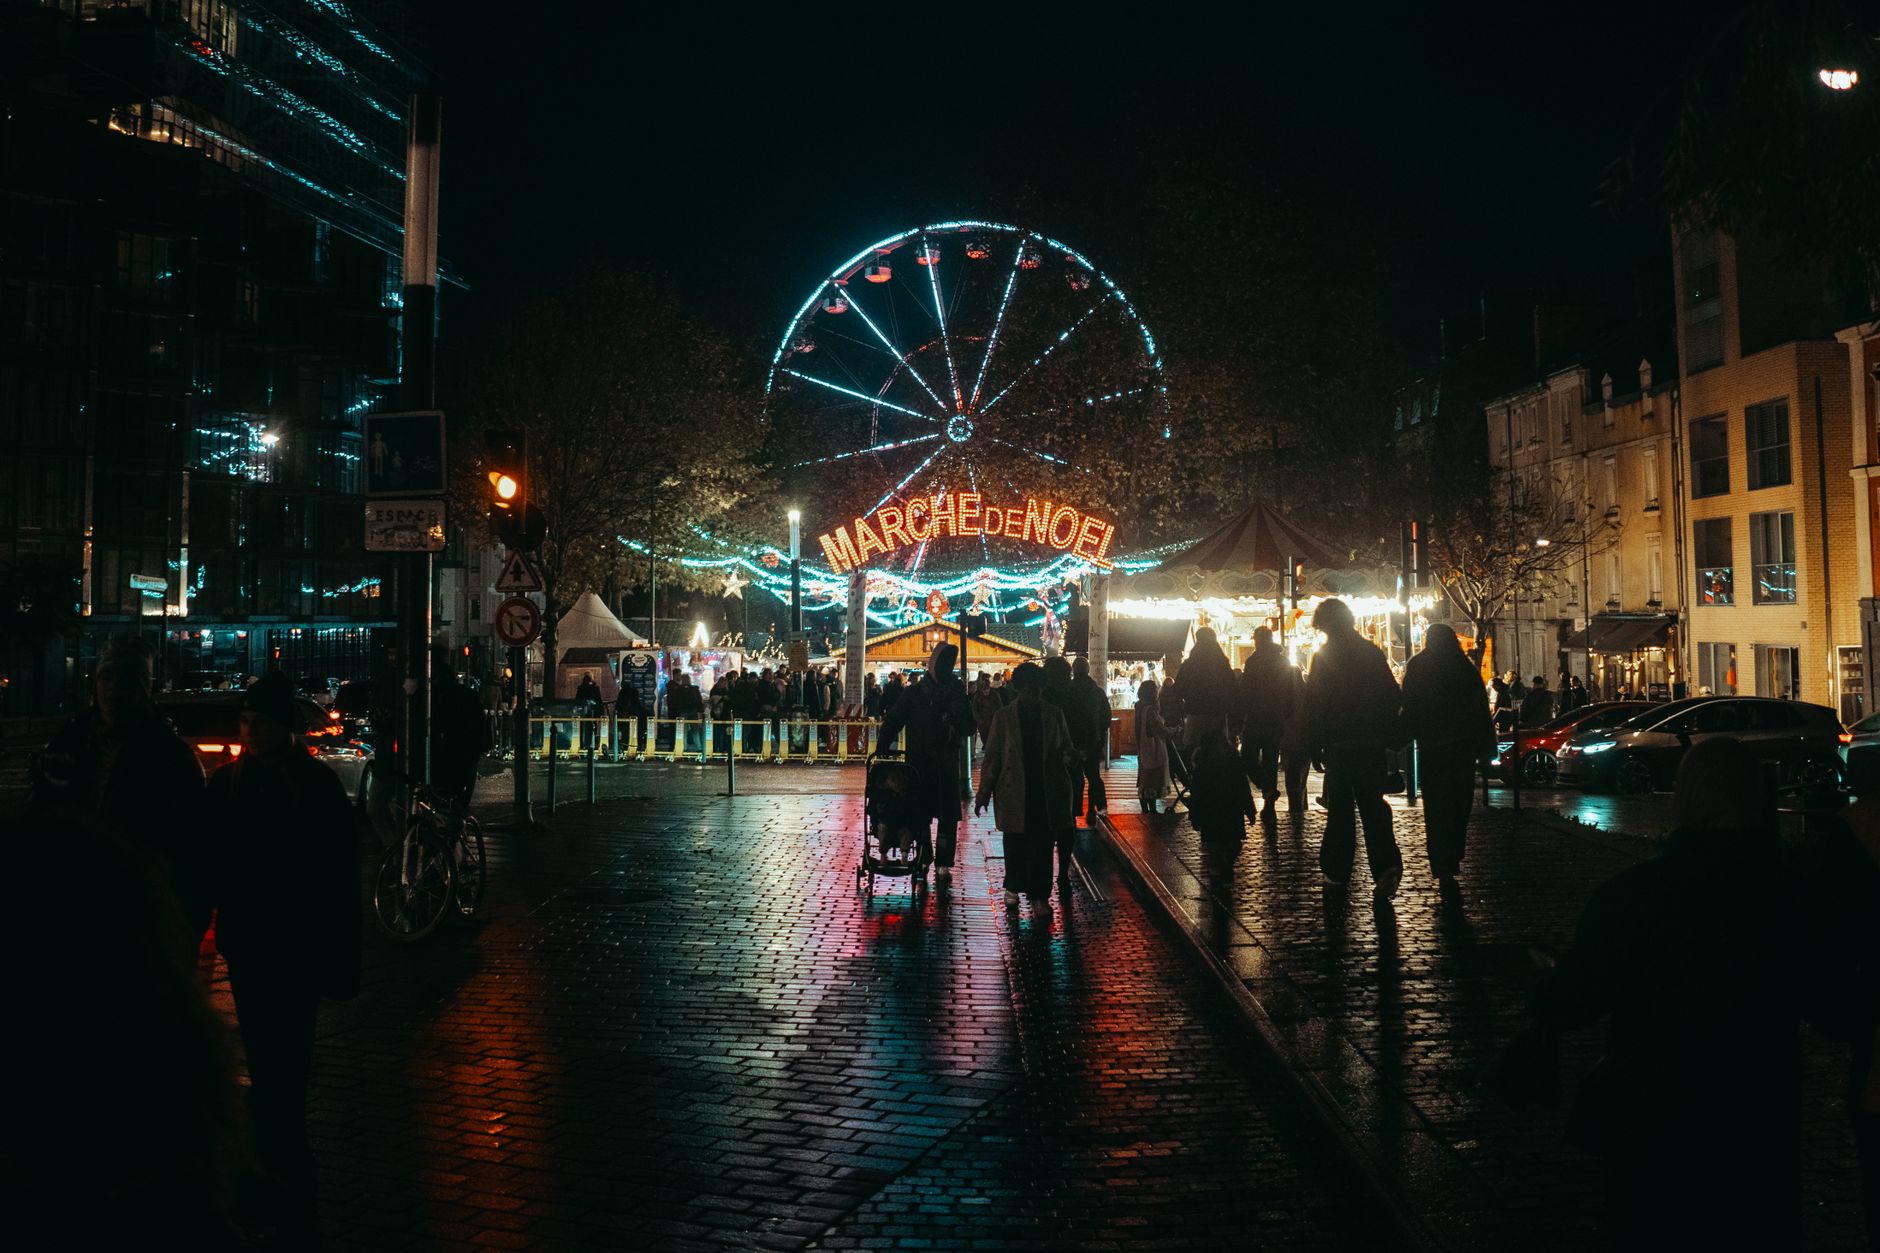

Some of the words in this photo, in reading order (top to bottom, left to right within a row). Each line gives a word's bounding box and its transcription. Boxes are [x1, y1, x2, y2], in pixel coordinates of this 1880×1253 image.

[818, 493, 981, 575] MARCHE
[985, 506, 1024, 537] DE
[1023, 498, 1115, 570] NOEL
